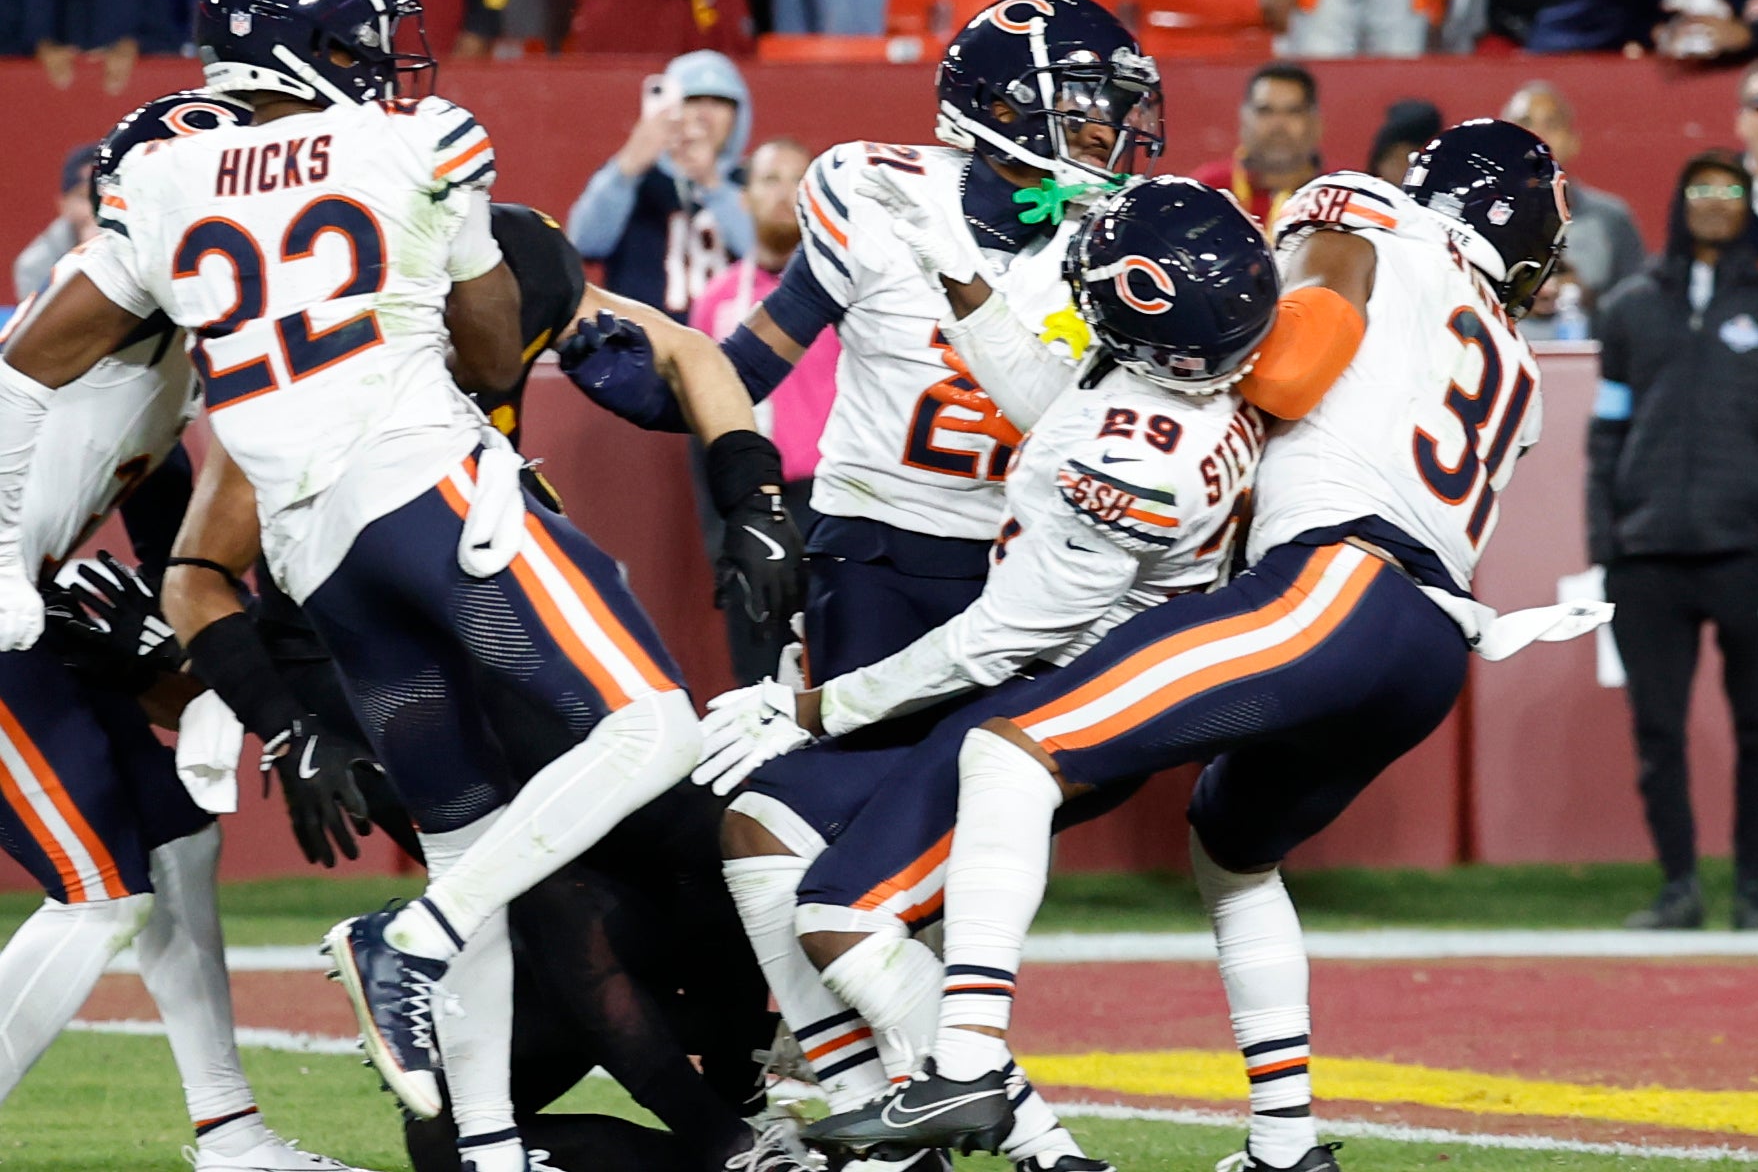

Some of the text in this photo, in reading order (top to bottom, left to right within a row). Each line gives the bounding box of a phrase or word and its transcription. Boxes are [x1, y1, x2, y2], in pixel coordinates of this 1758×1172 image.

[215, 134, 334, 197] HICKS
[172, 193, 390, 415] 22
[1097, 407, 1184, 455] 29
[1412, 304, 1535, 550] 31
[1071, 473, 1139, 522] GSH
